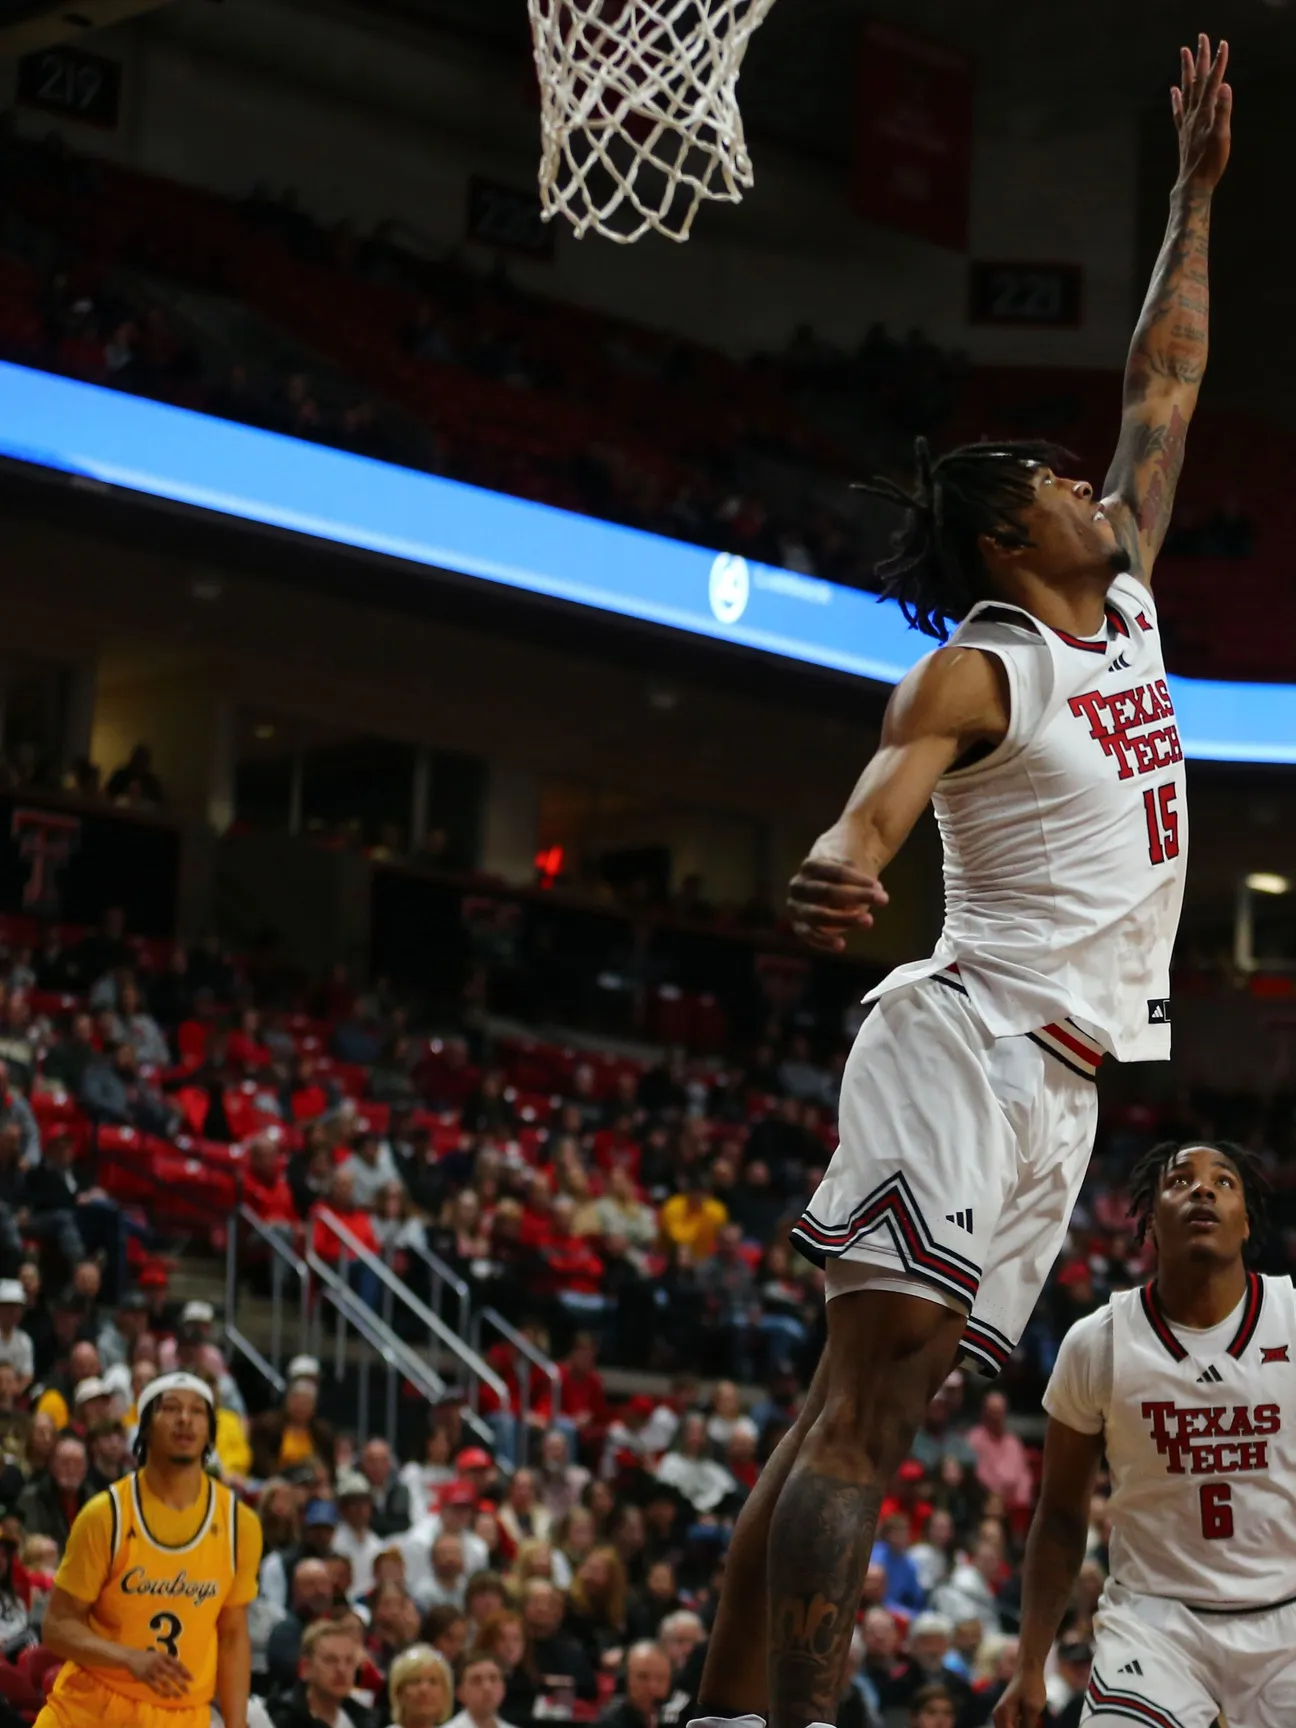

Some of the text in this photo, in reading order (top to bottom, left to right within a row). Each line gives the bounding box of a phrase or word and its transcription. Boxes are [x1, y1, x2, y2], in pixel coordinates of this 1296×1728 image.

[1067, 678, 1174, 739] TEXAS
[1098, 724, 1184, 781] TECH
[1143, 782, 1180, 866] 15
[1141, 1401, 1282, 1442] TEXAS
[1156, 1436, 1269, 1475] TECH
[1200, 1482, 1234, 1540] 6
[120, 1566, 219, 1607] Cowboys
[147, 1610, 183, 1659] 3
